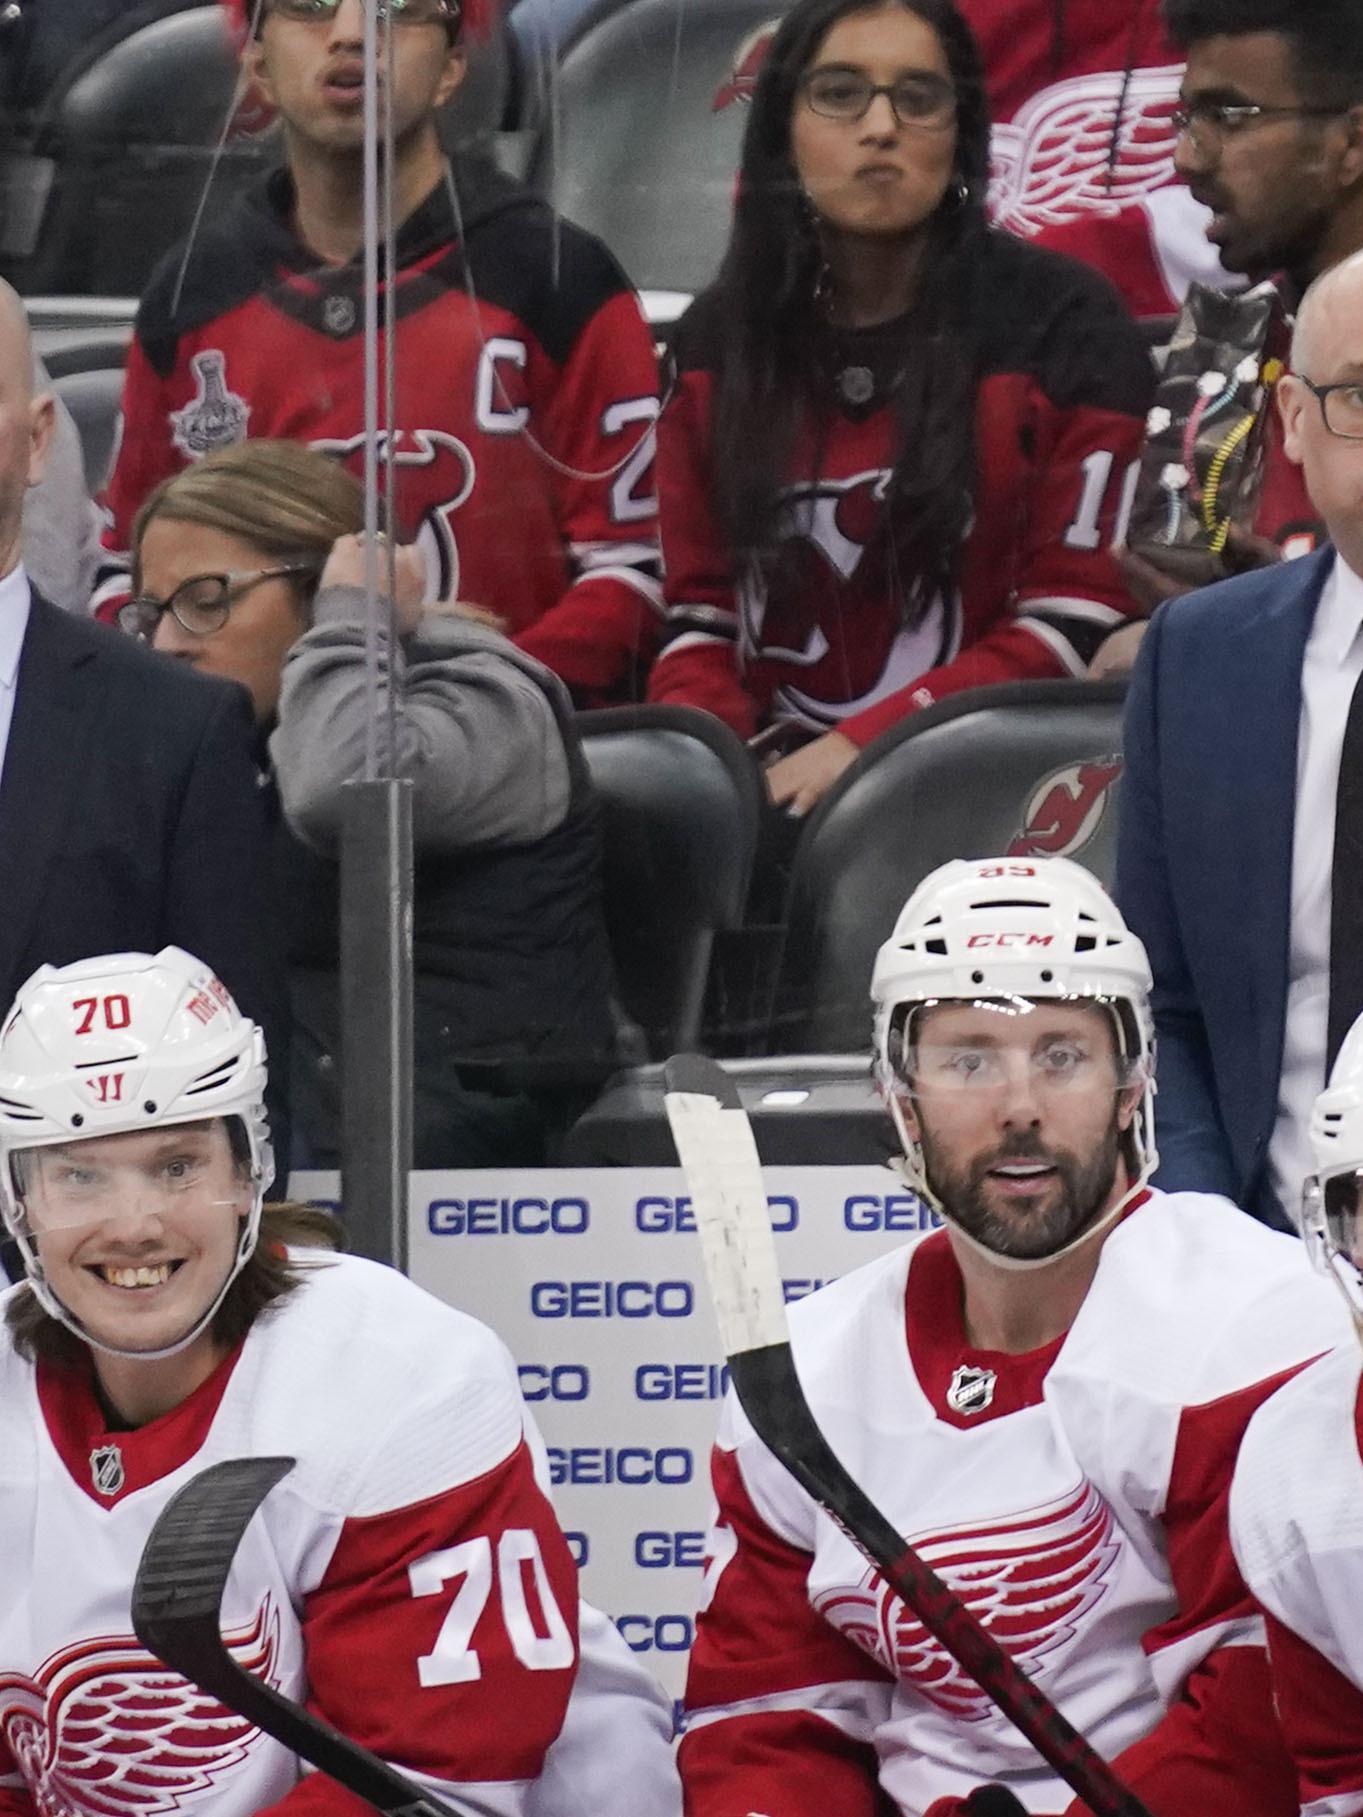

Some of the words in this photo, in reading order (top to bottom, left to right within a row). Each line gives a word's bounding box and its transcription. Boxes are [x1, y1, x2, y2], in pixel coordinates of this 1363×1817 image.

[478, 338, 530, 434] C
[966, 933, 1054, 949] CCM
[72, 994, 131, 1035] 70
[428, 1198, 592, 1236] GEICO
[635, 1196, 798, 1233] GEO
[531, 1281, 694, 1318] GEICO
[408, 1528, 575, 1688] 70
